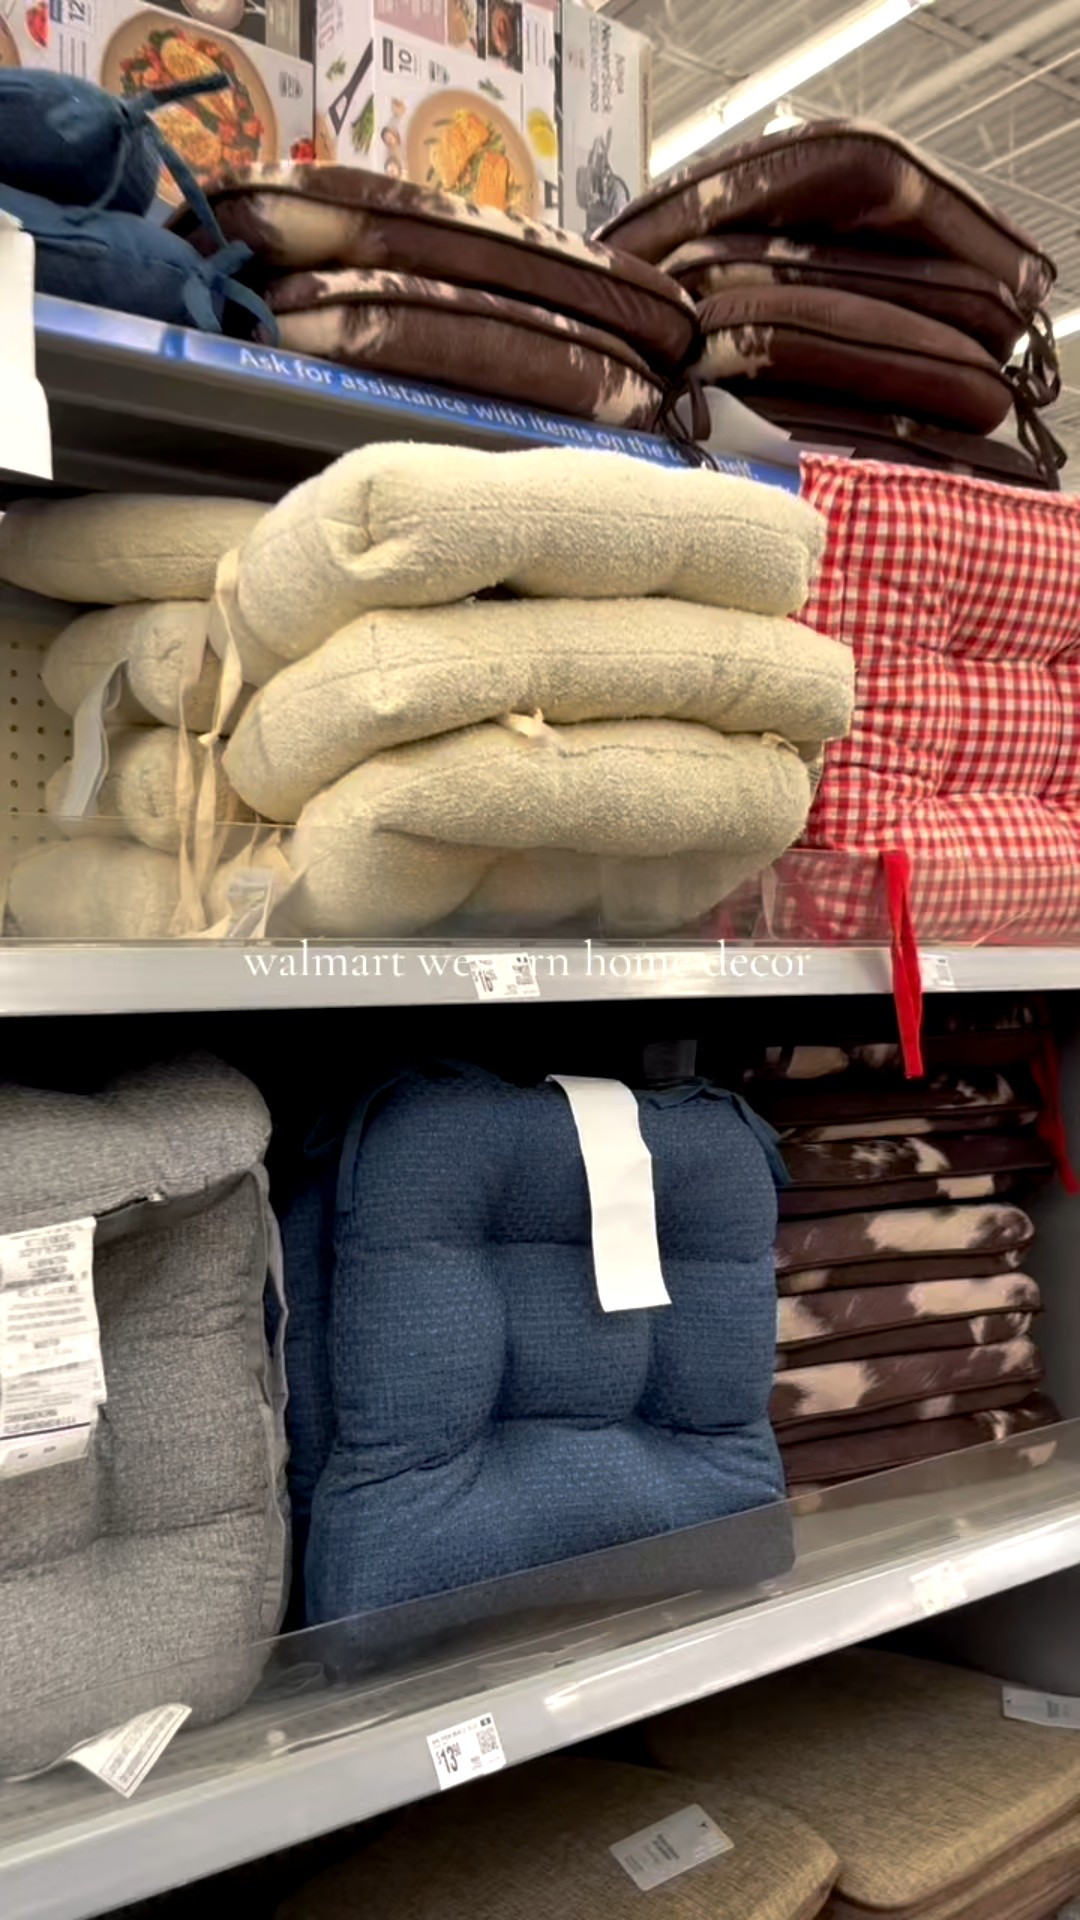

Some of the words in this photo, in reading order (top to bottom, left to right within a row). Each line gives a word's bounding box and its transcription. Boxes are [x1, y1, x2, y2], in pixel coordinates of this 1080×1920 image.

[68, 1, 86, 22] 12
[398, 50, 413, 73] 10
[239, 347, 290, 375] Ask
[294, 360, 333, 385] for
[341, 374, 469, 414] assistance
[475, 402, 528, 430] with
[530, 416, 593, 443] items
[597, 432, 626, 453] on
[628, 437, 664, 459] the
